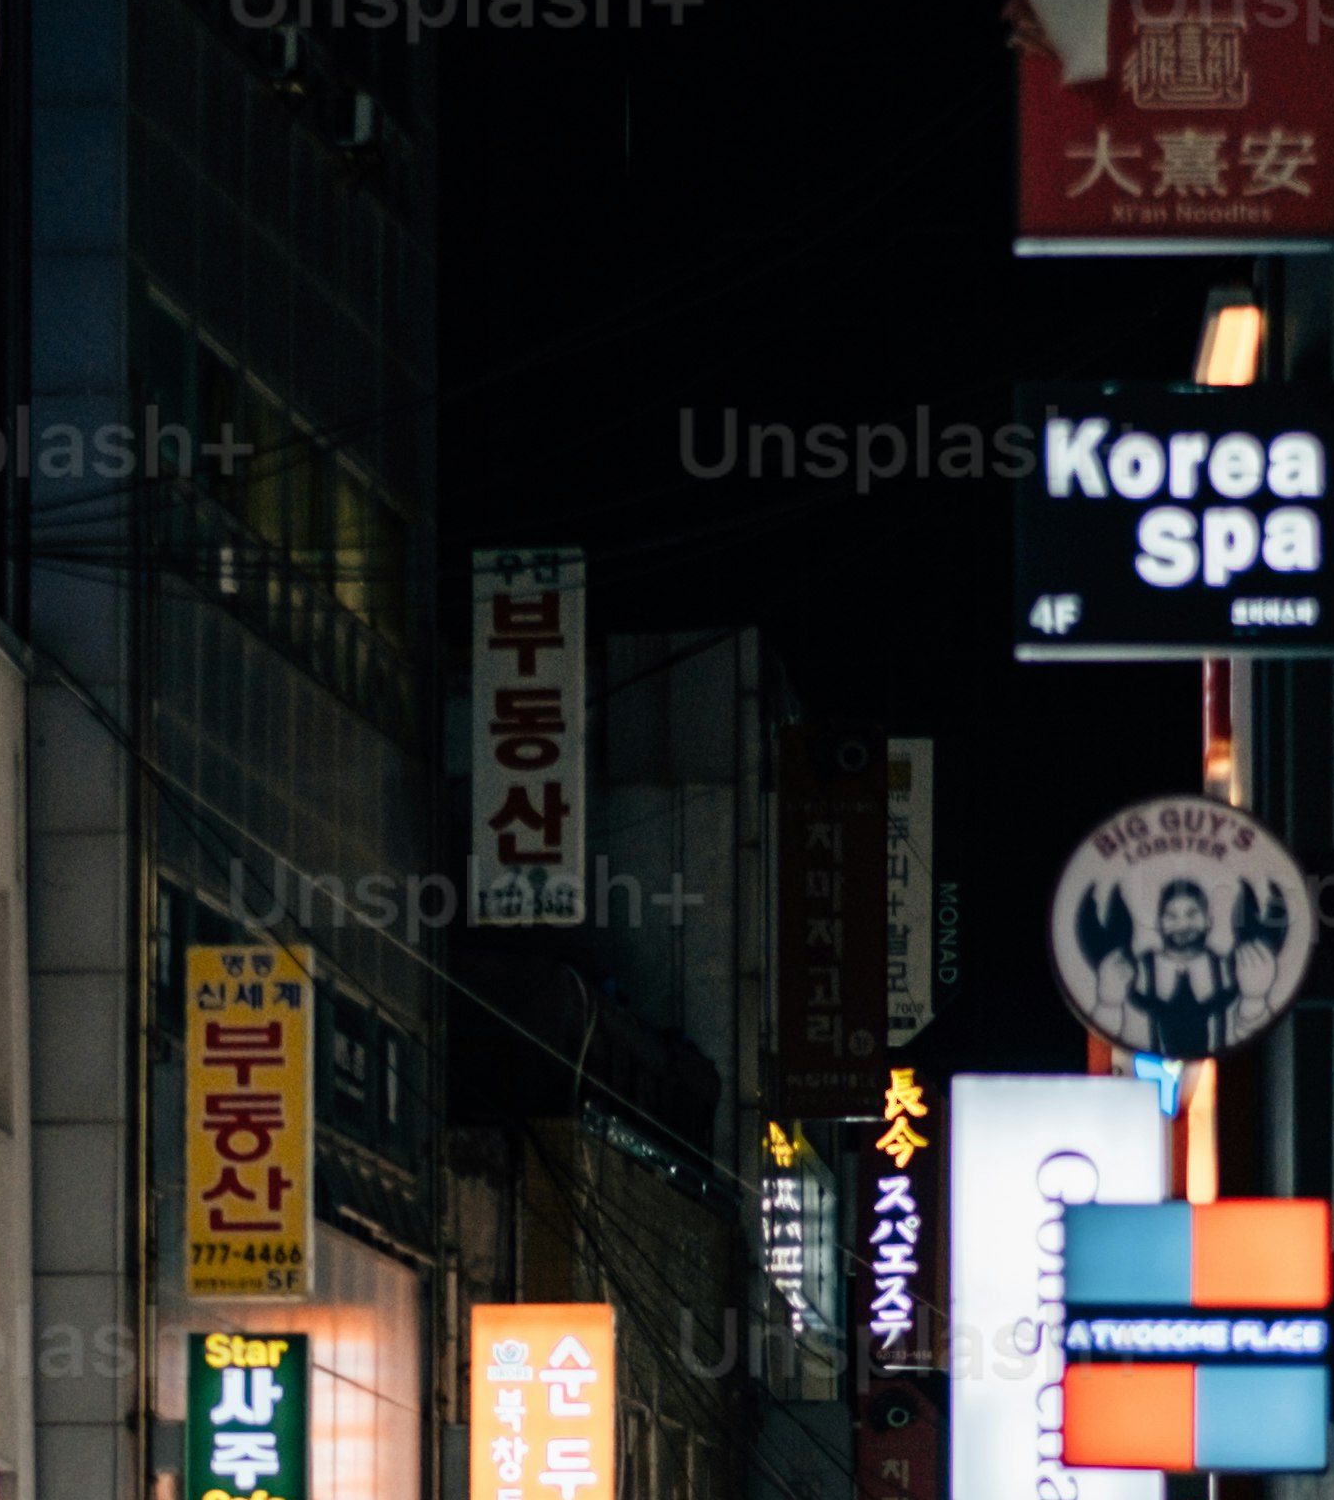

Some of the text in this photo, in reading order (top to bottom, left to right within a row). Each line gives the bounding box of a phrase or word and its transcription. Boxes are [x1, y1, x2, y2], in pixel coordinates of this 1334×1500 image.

[1045, 416, 1327, 499] Korea
[1029, 593, 1082, 635] 4F
[488, 590, 570, 864] 부동산
[1094, 806, 1255, 858] BIG GUY'S
[938, 880, 960, 985] MONAD
[197, 982, 301, 1011] 신세계
[202, 1021, 292, 1233] 부동산
[875, 1067, 930, 1169] 長今
[190, 1242, 303, 1266] 777-4466
[268, 1271, 300, 1291] 5F
[868, 1175, 922, 1351] スパエステ
[204, 1332, 289, 1368] Star
[1090, 1319, 1229, 1352] TWOSOME
[1231, 1319, 1326, 1353] PLACE
[209, 1367, 284, 1491] 사주
